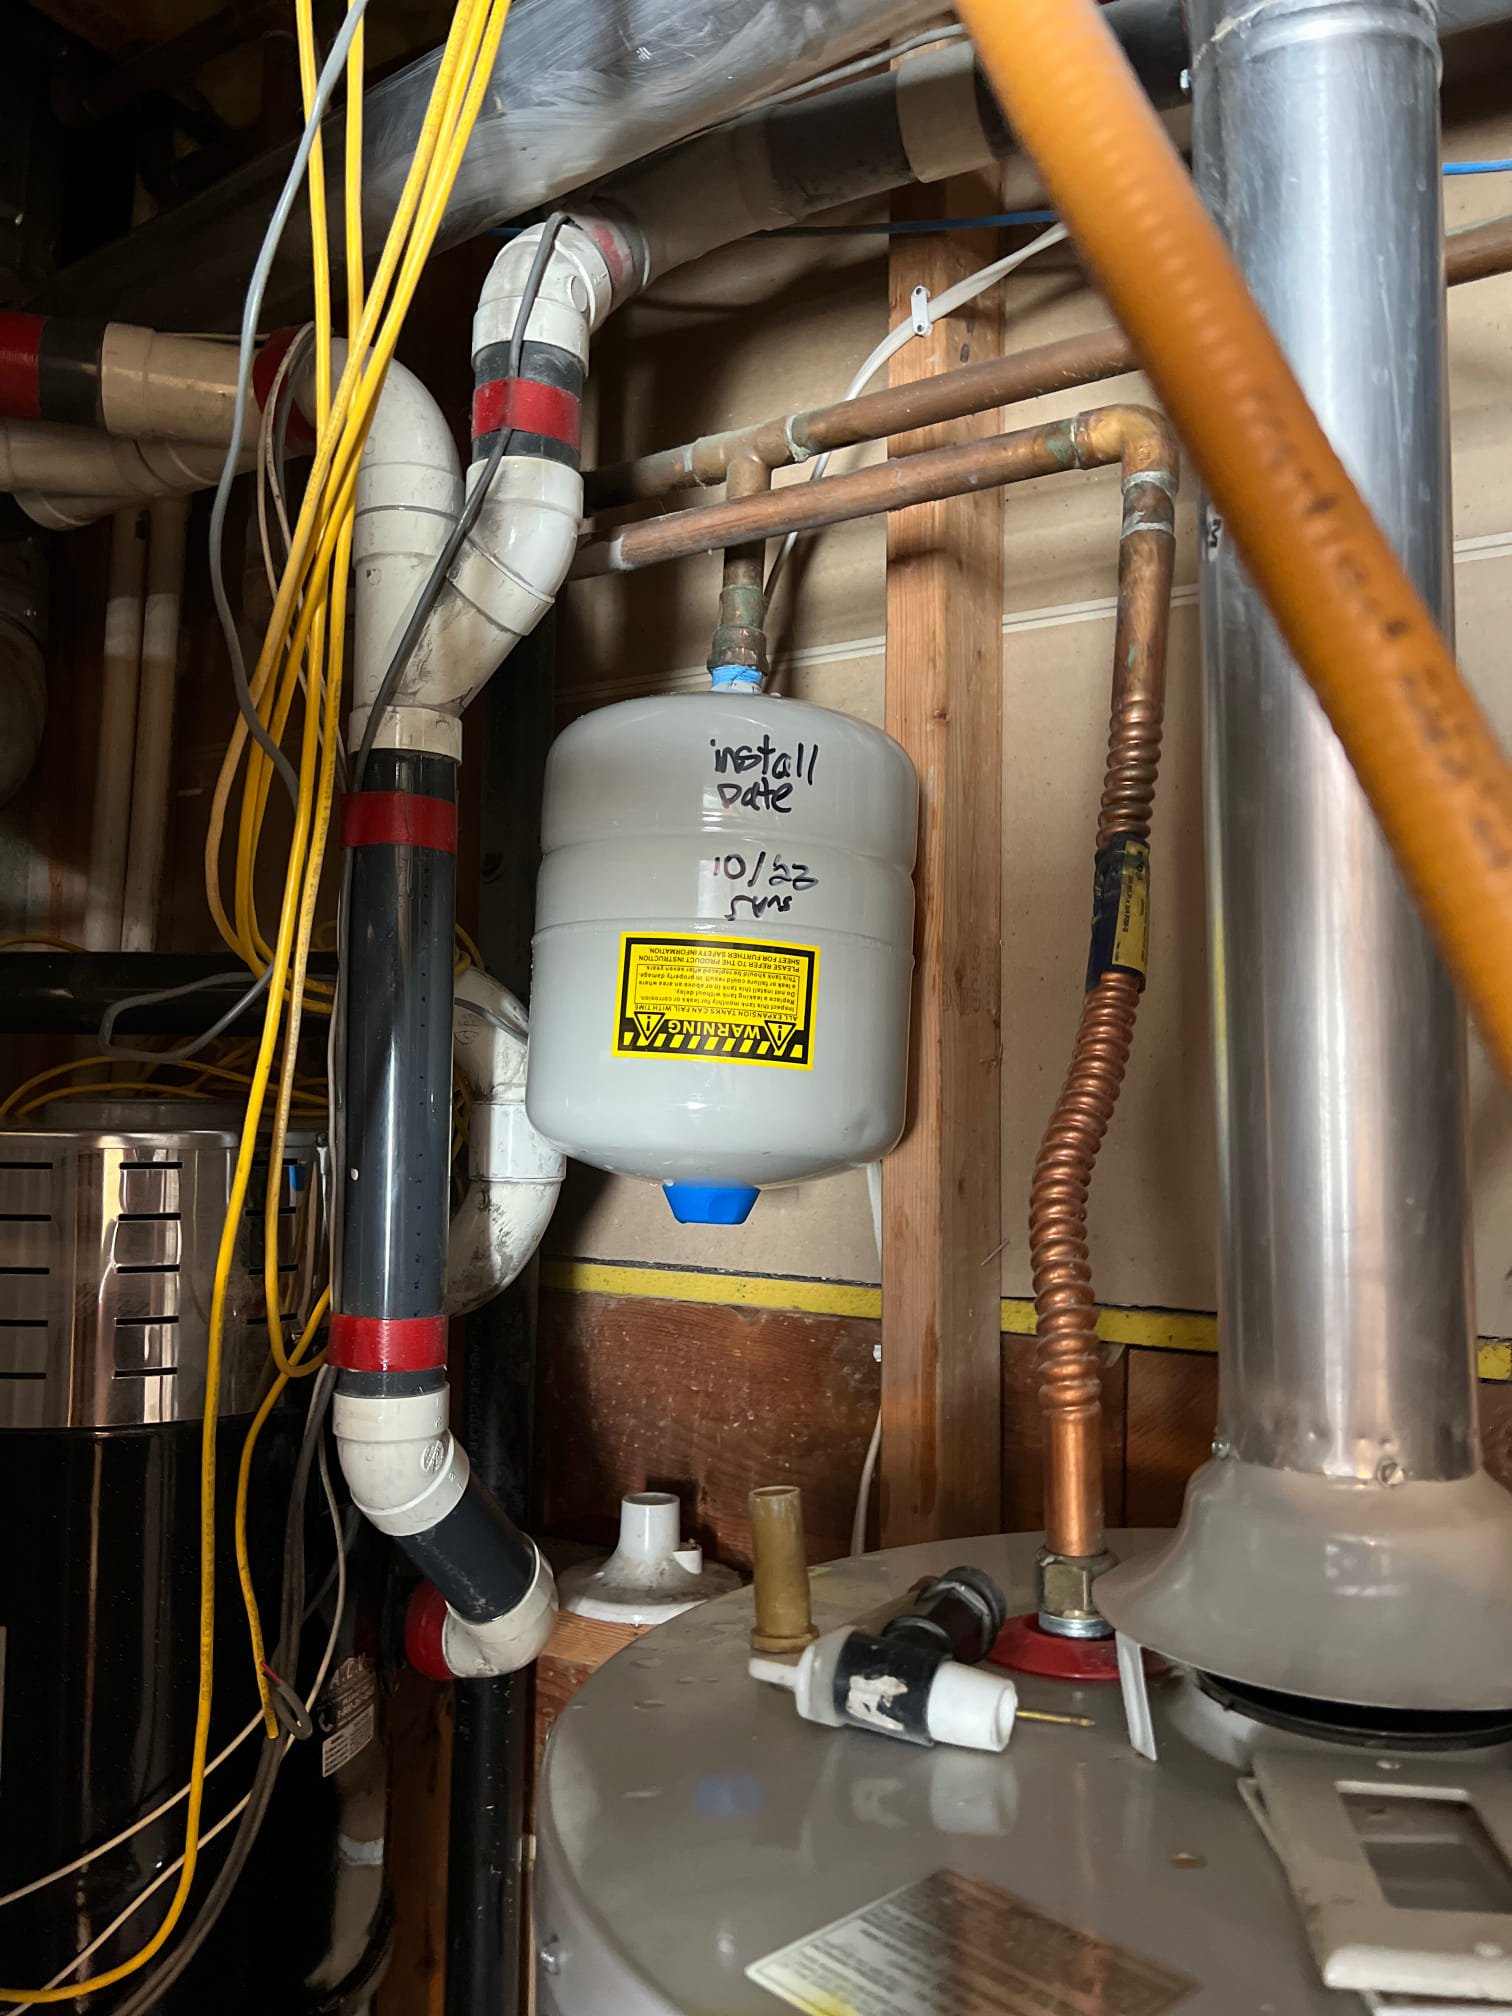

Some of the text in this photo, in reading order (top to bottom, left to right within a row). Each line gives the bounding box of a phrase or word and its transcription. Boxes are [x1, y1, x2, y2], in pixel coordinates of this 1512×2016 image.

[710, 734, 819, 785] install
[717, 776, 793, 813] Date
[699, 951, 726, 959] SAFETY
[728, 953, 760, 961] FURTHER
[686, 957, 720, 965] PRODUCT
[667, 973, 694, 981] property
[747, 980, 768, 988] failure
[739, 993, 762, 1002] leaking
[738, 1010, 782, 1020] EXPANSION
[668, 1020, 760, 1039] WARNING
